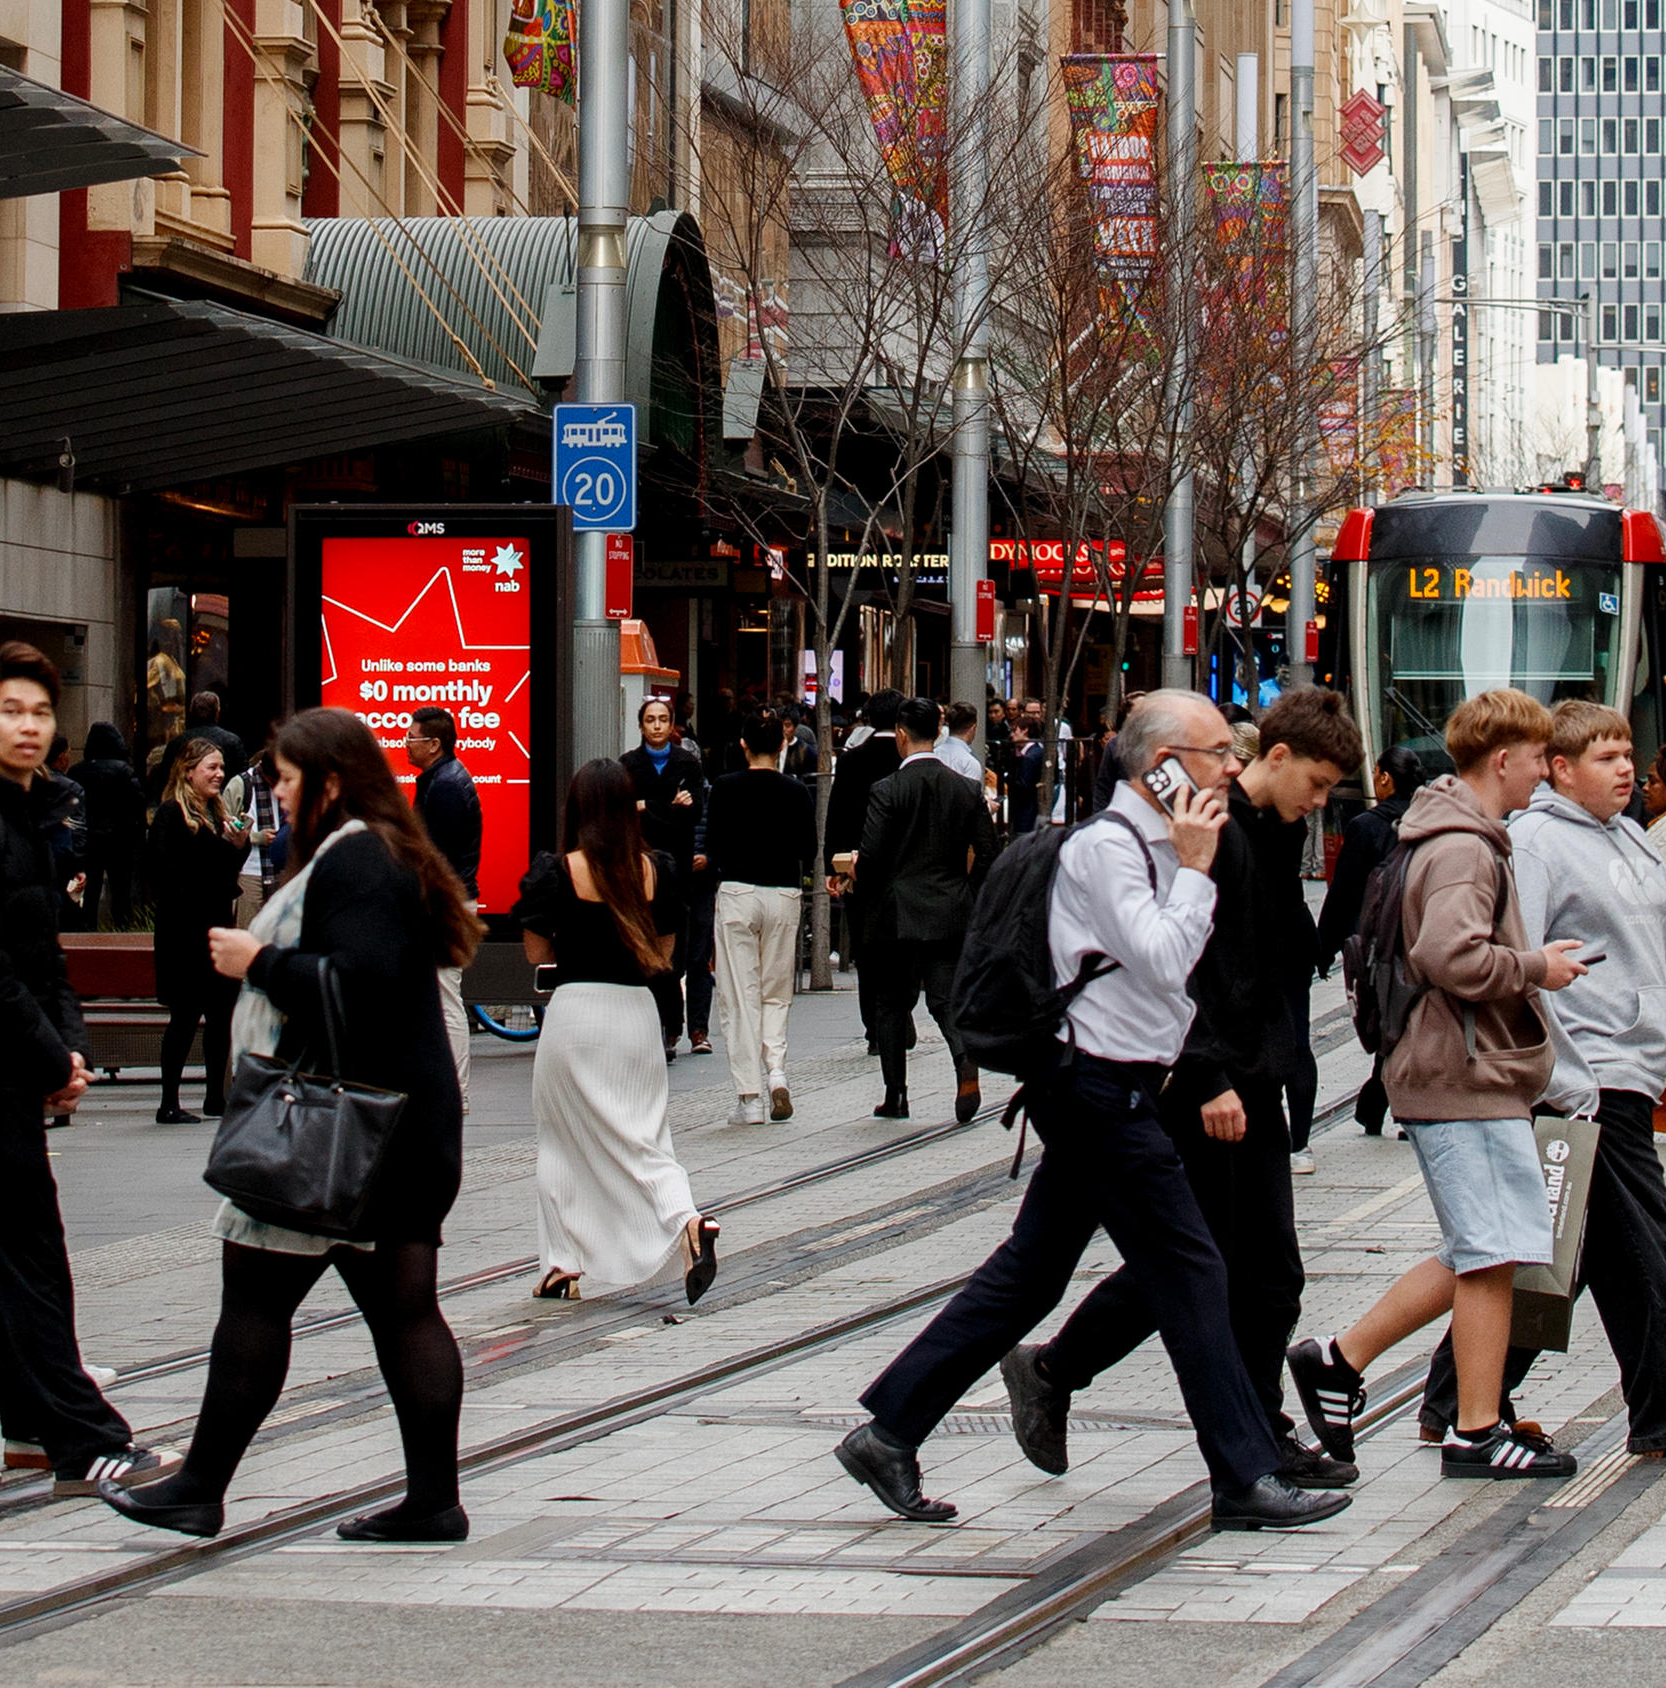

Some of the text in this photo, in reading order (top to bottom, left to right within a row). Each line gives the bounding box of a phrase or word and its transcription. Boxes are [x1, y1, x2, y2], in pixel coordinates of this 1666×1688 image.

[1452, 274, 1466, 471] GALERIES
[575, 473, 615, 505] 20
[462, 548, 485, 556] more
[614, 539, 623, 549] NO
[462, 556, 483, 564] than
[990, 543, 1090, 562] DYMOCS
[462, 564, 492, 573] money
[495, 580, 520, 592] nab
[1409, 568, 1572, 598] L2 Randwick
[361, 659, 490, 672] Unlike some banks
[359, 679, 493, 706] $0 monthly
[458, 706, 500, 729] fee
